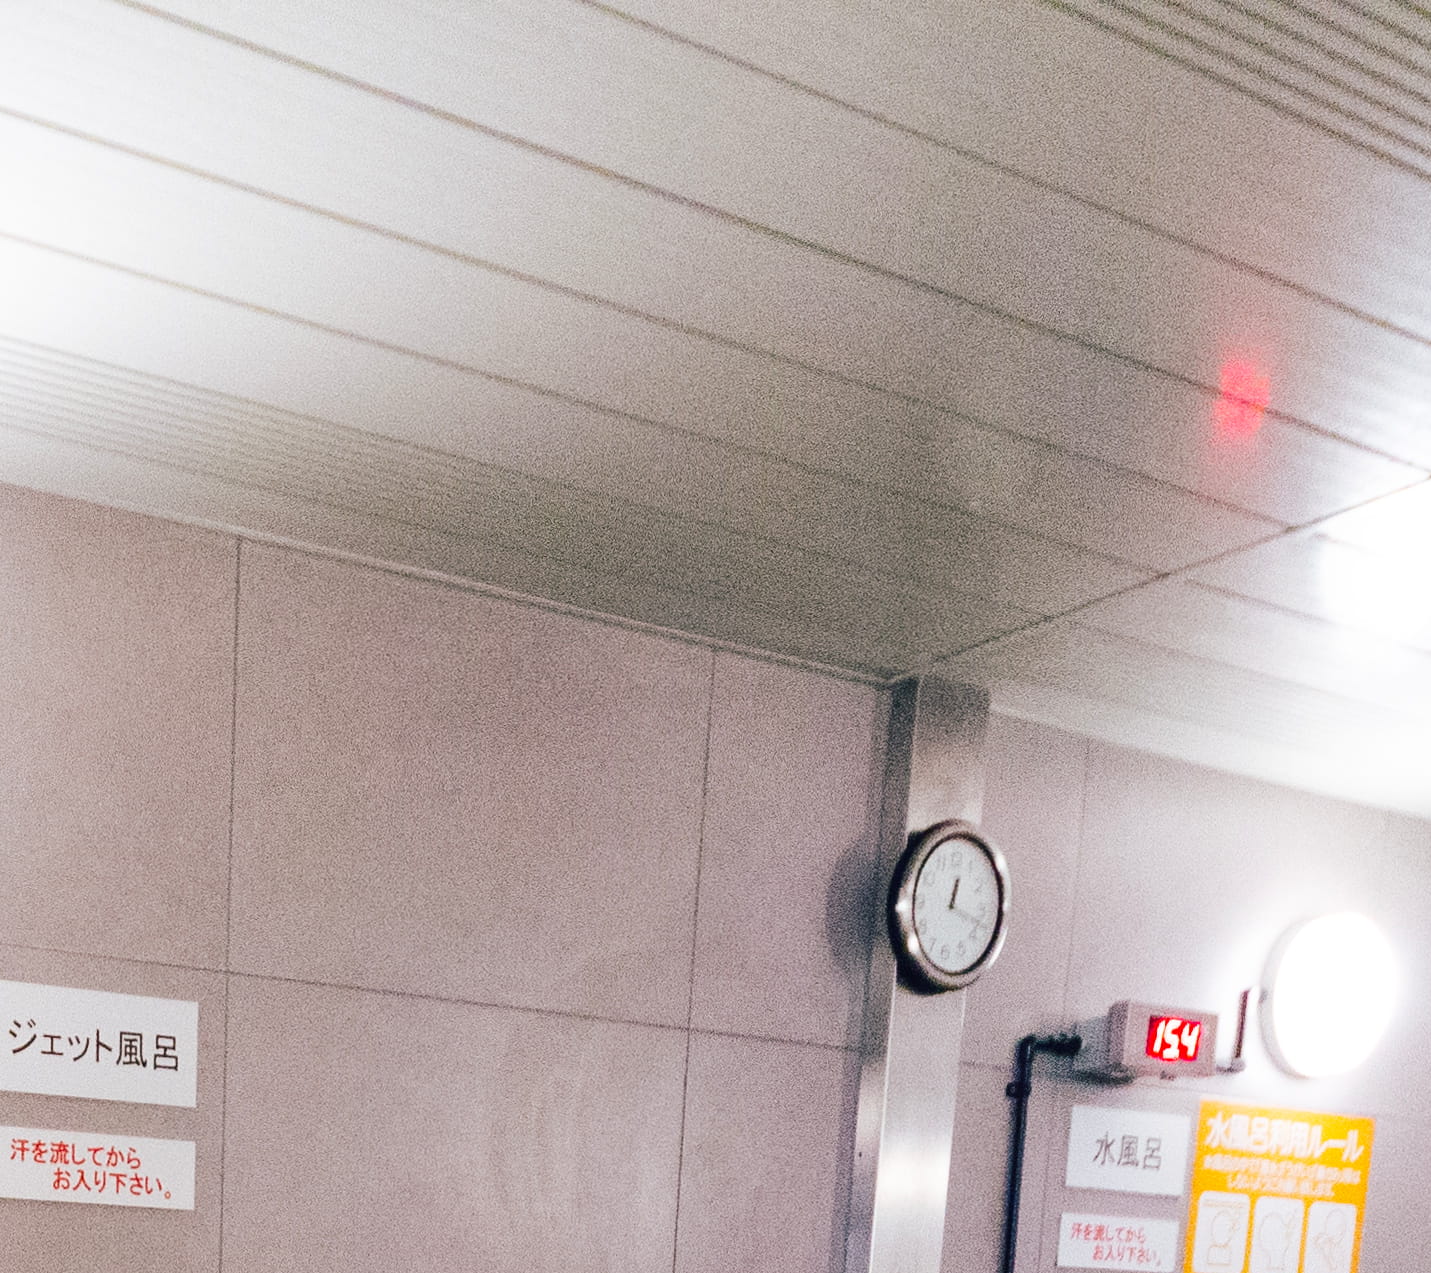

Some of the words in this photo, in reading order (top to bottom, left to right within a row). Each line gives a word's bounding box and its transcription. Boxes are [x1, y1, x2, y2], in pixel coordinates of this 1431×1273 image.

[8, 1018, 179, 1071] ジェット風呂
[9, 1138, 142, 1169] 汗を流してから
[1093, 1131, 1162, 1170] 水風呂
[1204, 1112, 1364, 1162] 水風呂利用ルール
[52, 1167, 172, 1200] お入り下さい。
